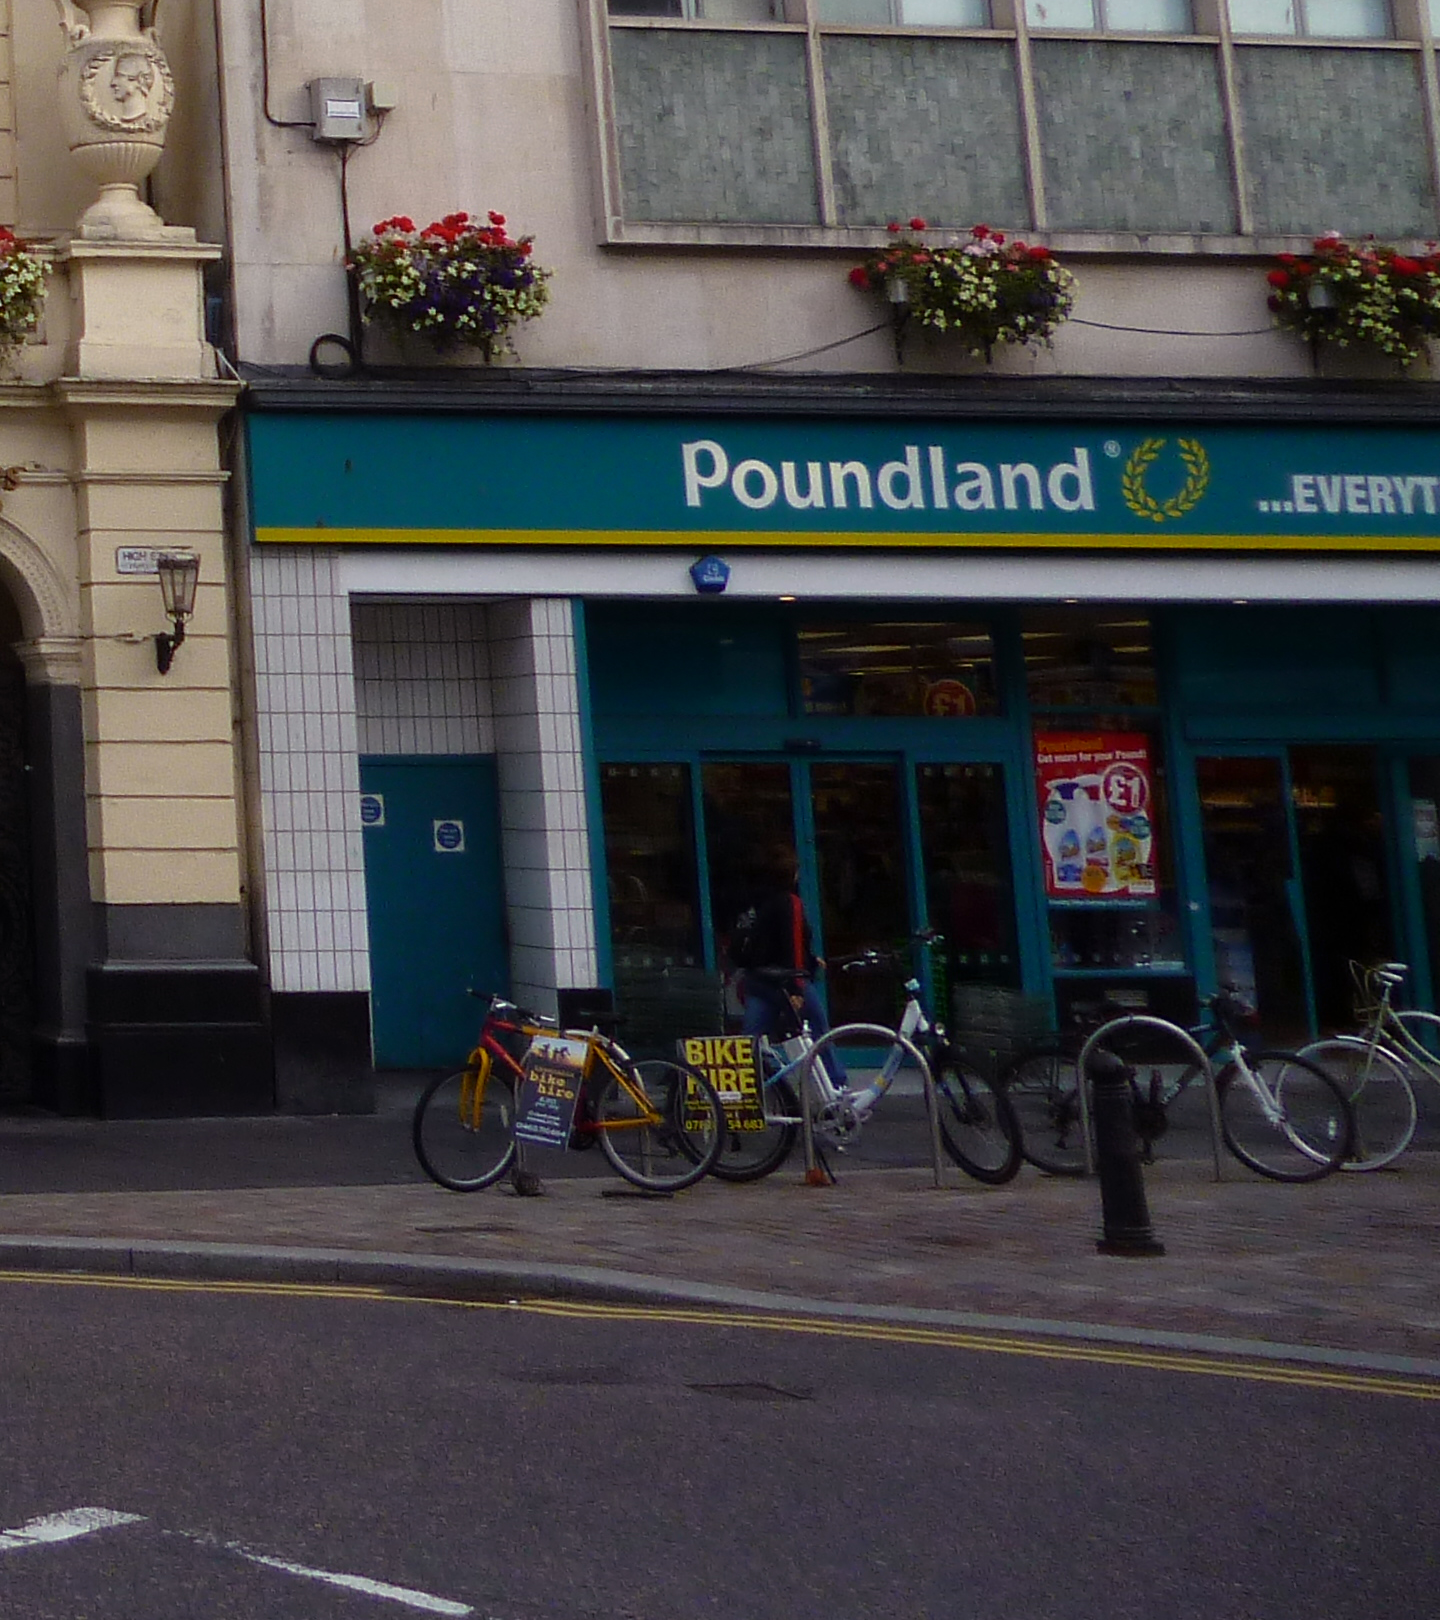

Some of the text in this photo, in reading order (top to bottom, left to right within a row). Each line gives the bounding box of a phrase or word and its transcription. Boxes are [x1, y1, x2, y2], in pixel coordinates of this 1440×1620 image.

[680, 438, 1097, 511] Poundland
[1109, 773, 1141, 808] £1
[685, 1038, 754, 1065] BIKE
[529, 1070, 566, 1087] bike
[537, 1083, 575, 1099] hire
